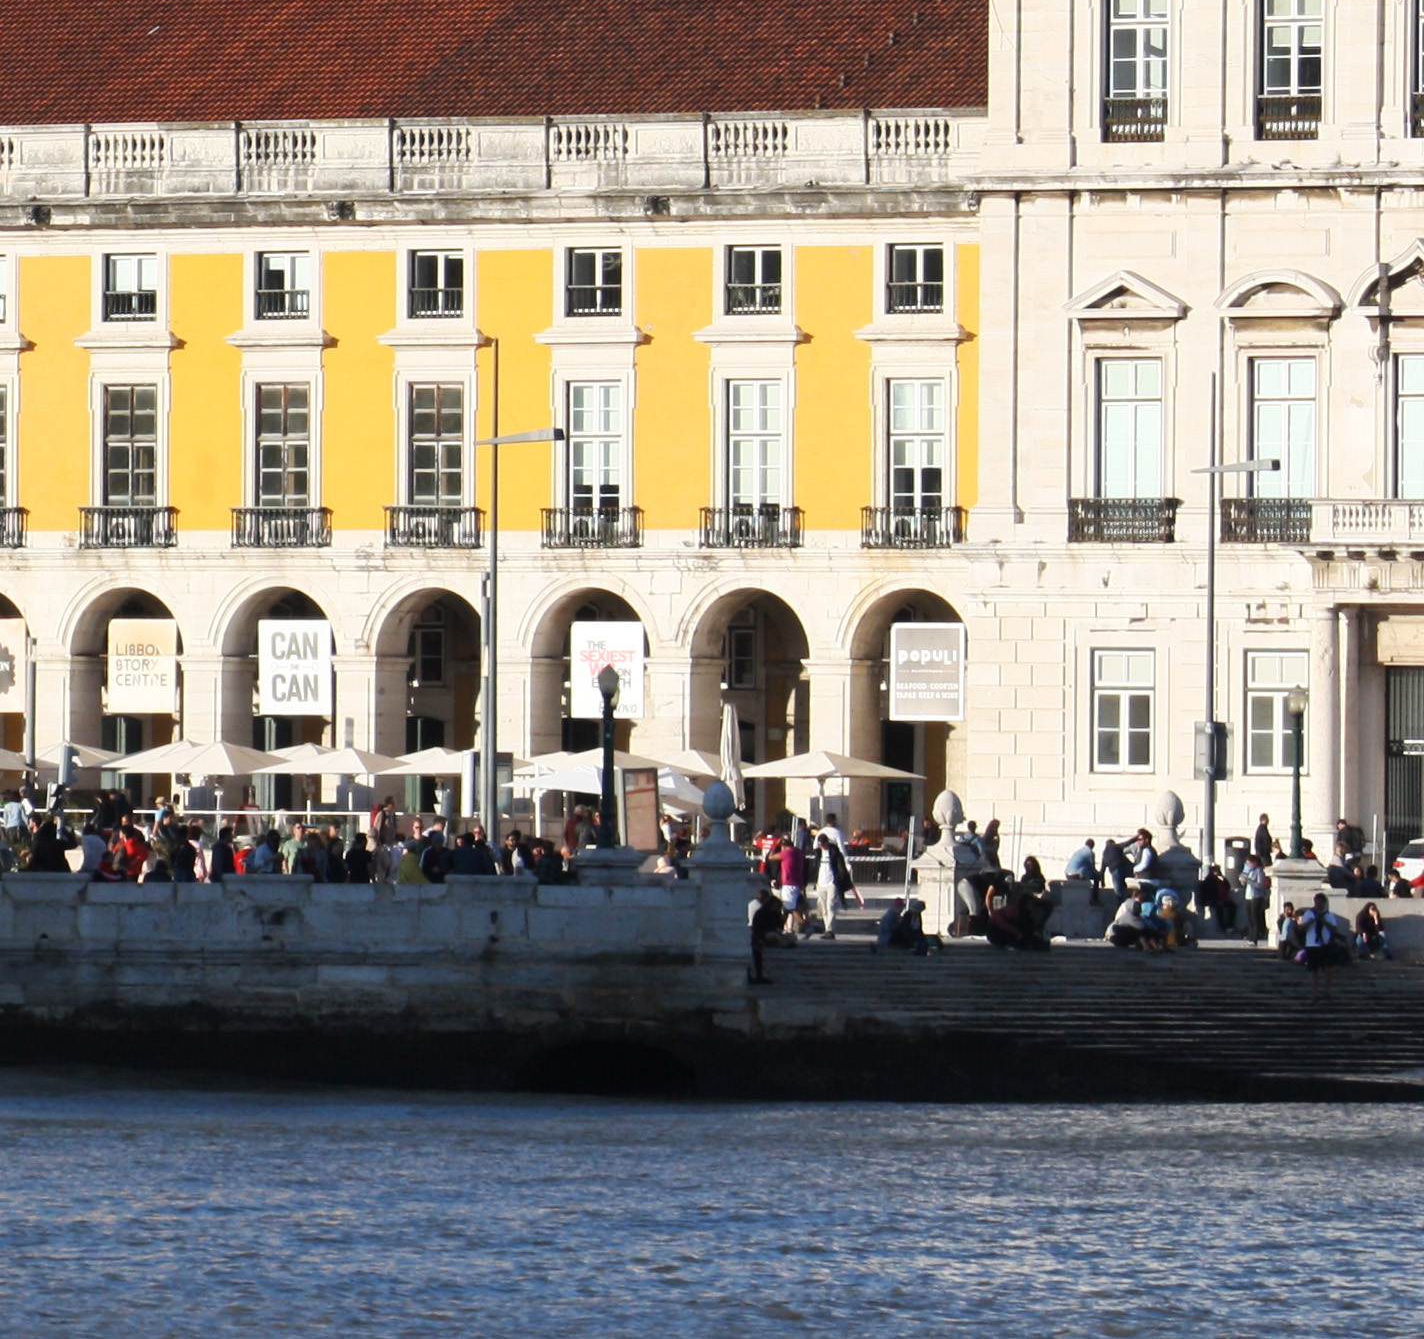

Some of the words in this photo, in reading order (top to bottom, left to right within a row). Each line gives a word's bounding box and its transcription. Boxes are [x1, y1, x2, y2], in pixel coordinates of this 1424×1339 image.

[271, 631, 319, 660] CAN
[586, 640, 607, 650] THE
[580, 650, 636, 662] SEXIEST
[115, 659, 159, 671] STORY
[115, 674, 168, 687] CENTRE
[271, 673, 319, 703] CAN
